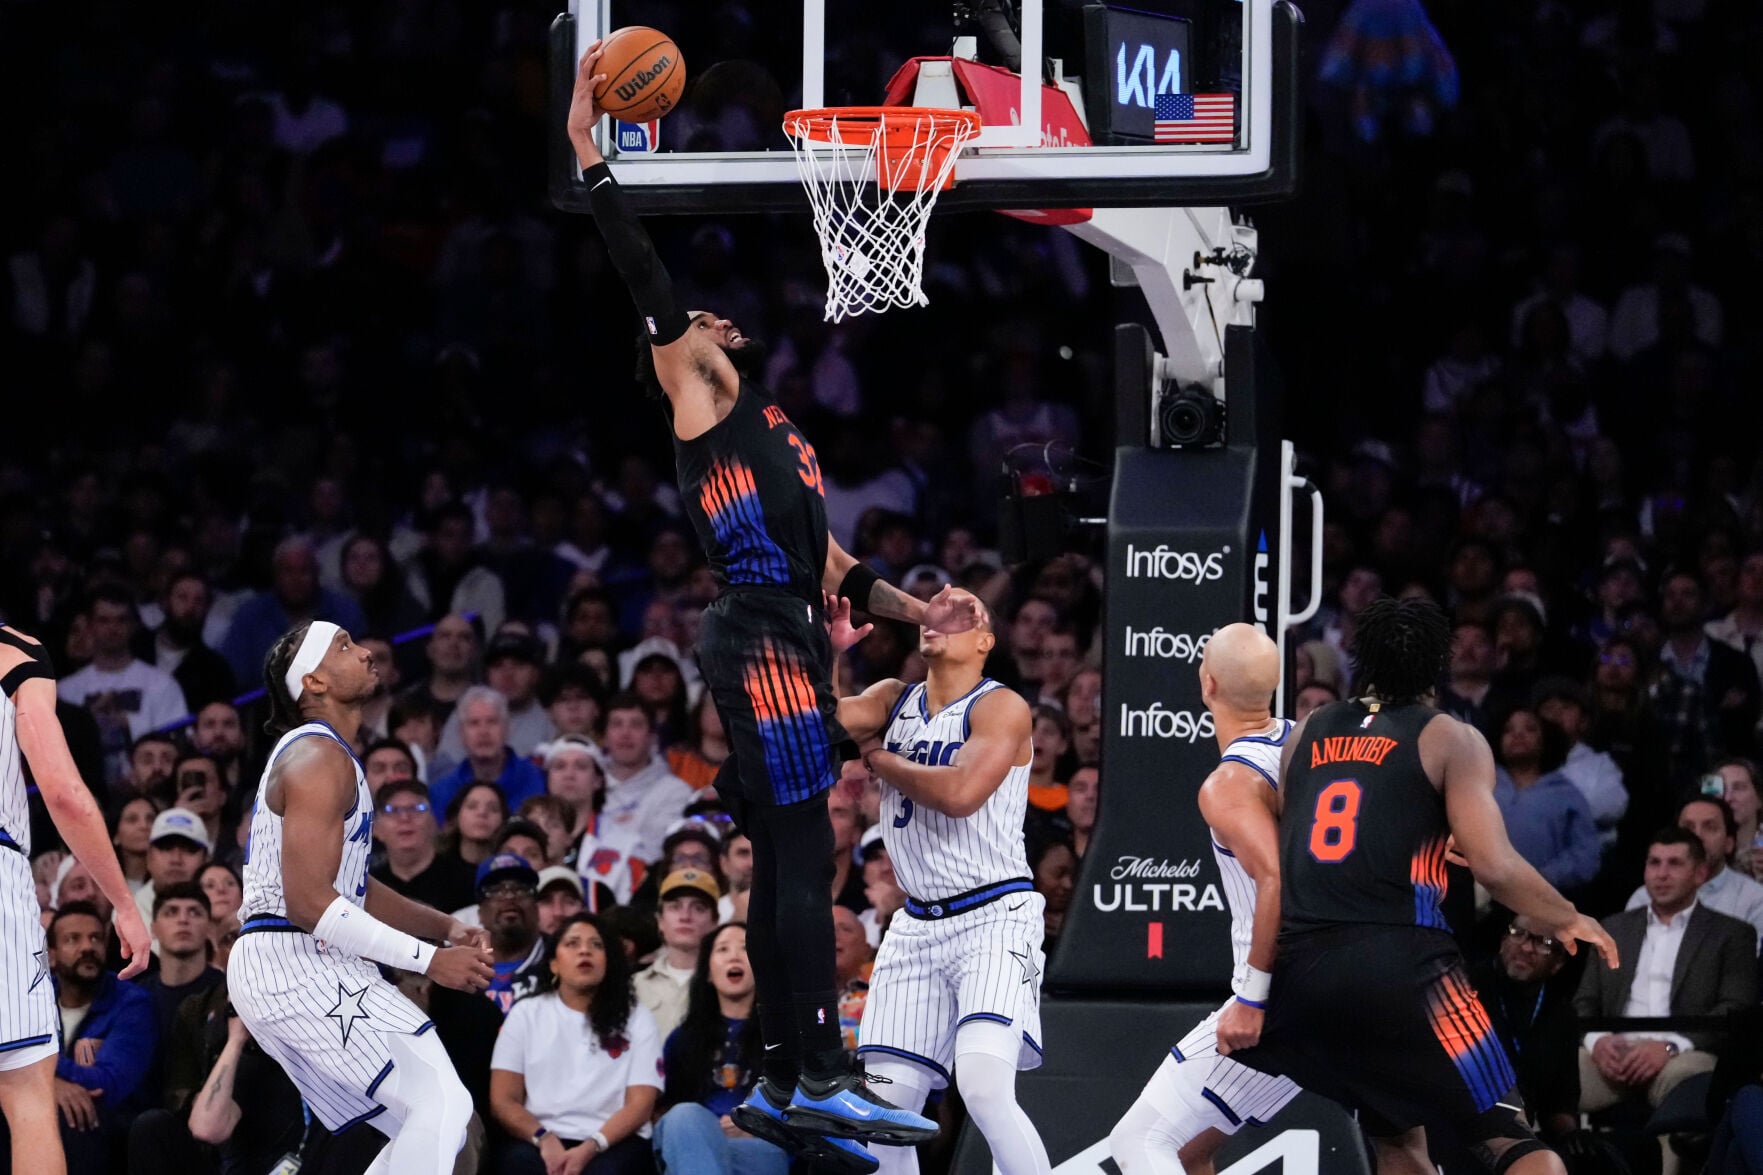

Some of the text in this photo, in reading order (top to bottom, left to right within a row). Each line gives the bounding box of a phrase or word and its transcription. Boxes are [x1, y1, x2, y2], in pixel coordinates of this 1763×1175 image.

[614, 56, 671, 101] Wilson
[622, 131, 642, 147] NBA
[1126, 544, 1224, 585] Infosys
[1121, 703, 1215, 743] Infosys
[1310, 736, 1398, 769] ANUNOBY
[1308, 777, 1363, 863] 8
[1110, 856, 1201, 880] Michelob
[1093, 884, 1225, 912] ULTRA
